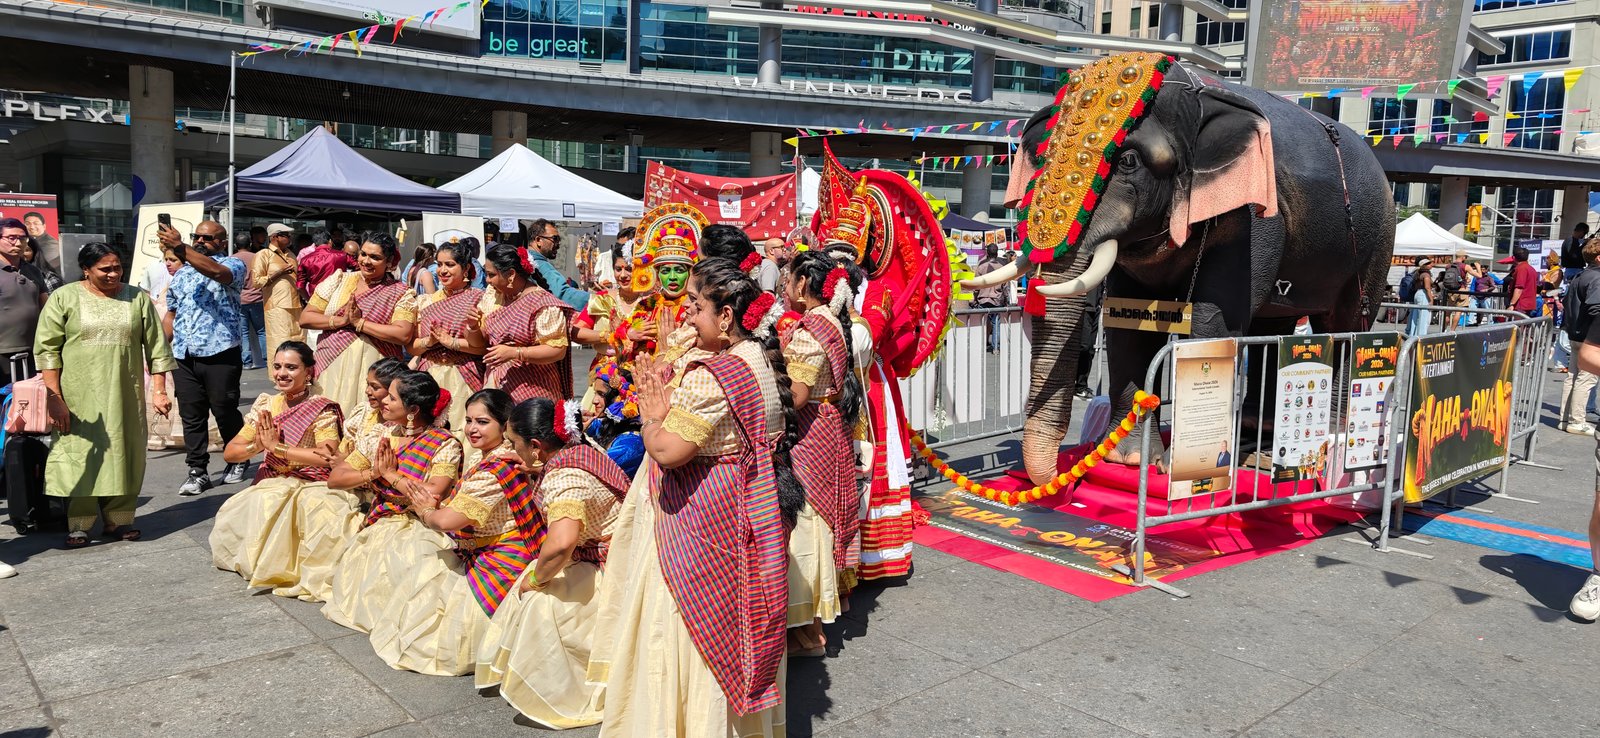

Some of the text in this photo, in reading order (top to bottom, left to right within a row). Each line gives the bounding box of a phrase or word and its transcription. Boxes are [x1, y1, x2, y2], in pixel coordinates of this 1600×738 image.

[489, 31, 596, 57] be great.
[893, 48, 974, 74] DMZ
[1355, 346, 1398, 368] MAHA ONAM
[1420, 341, 1456, 364] LEVITATE
[1413, 379, 1512, 486] MAHA ONAM
[1451, 464, 1473, 480] CELEBRATION
[1476, 459, 1490, 470] NORTH
[963, 530, 1023, 551] CELEBRATION
[1033, 551, 1069, 565] NORTH
[1067, 561, 1114, 578] AMERICA
